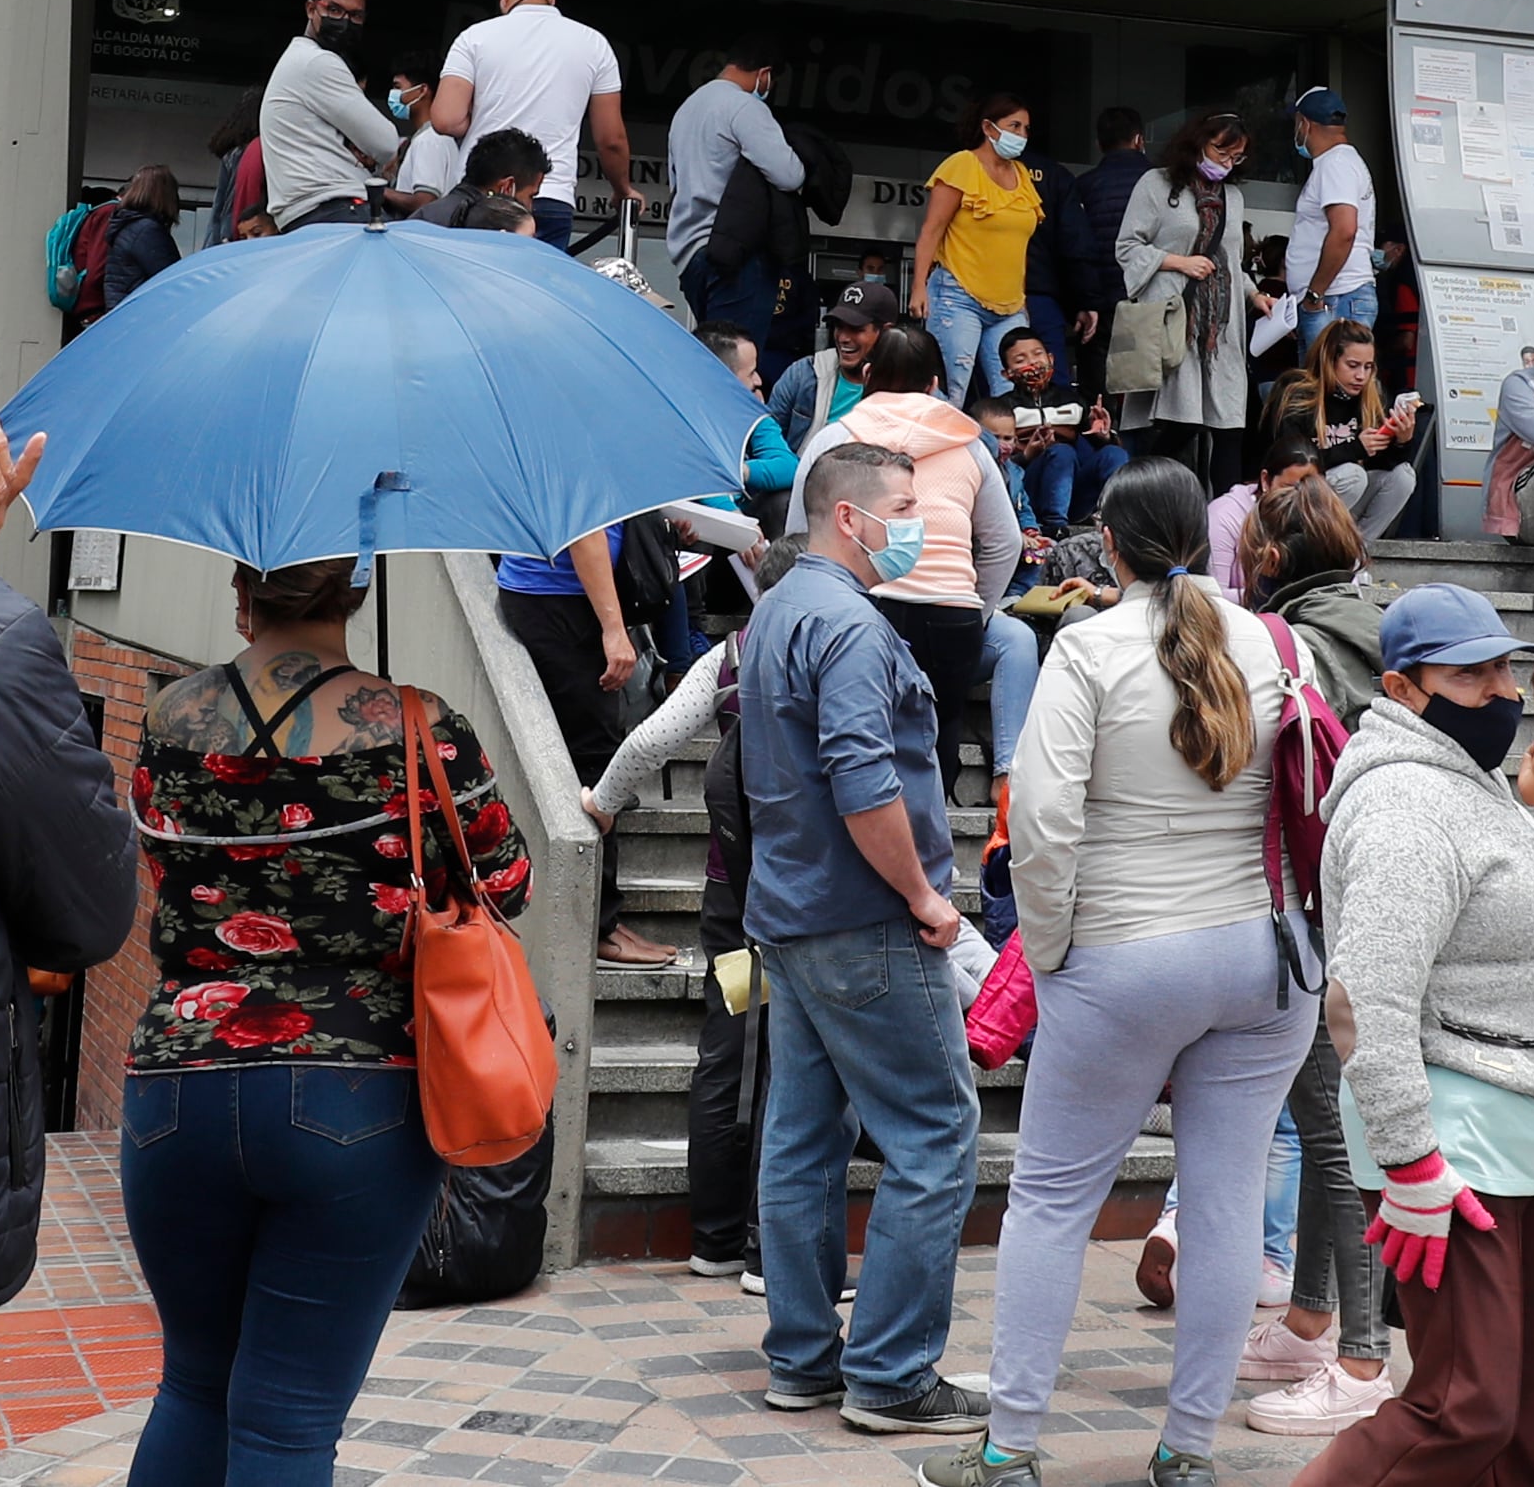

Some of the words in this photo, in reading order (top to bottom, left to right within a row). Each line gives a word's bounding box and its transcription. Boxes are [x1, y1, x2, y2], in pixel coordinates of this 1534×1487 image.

[154, 33, 201, 50] MAYOR
[93, 42, 110, 55] DE
[1450, 432, 1477, 444] vanti
